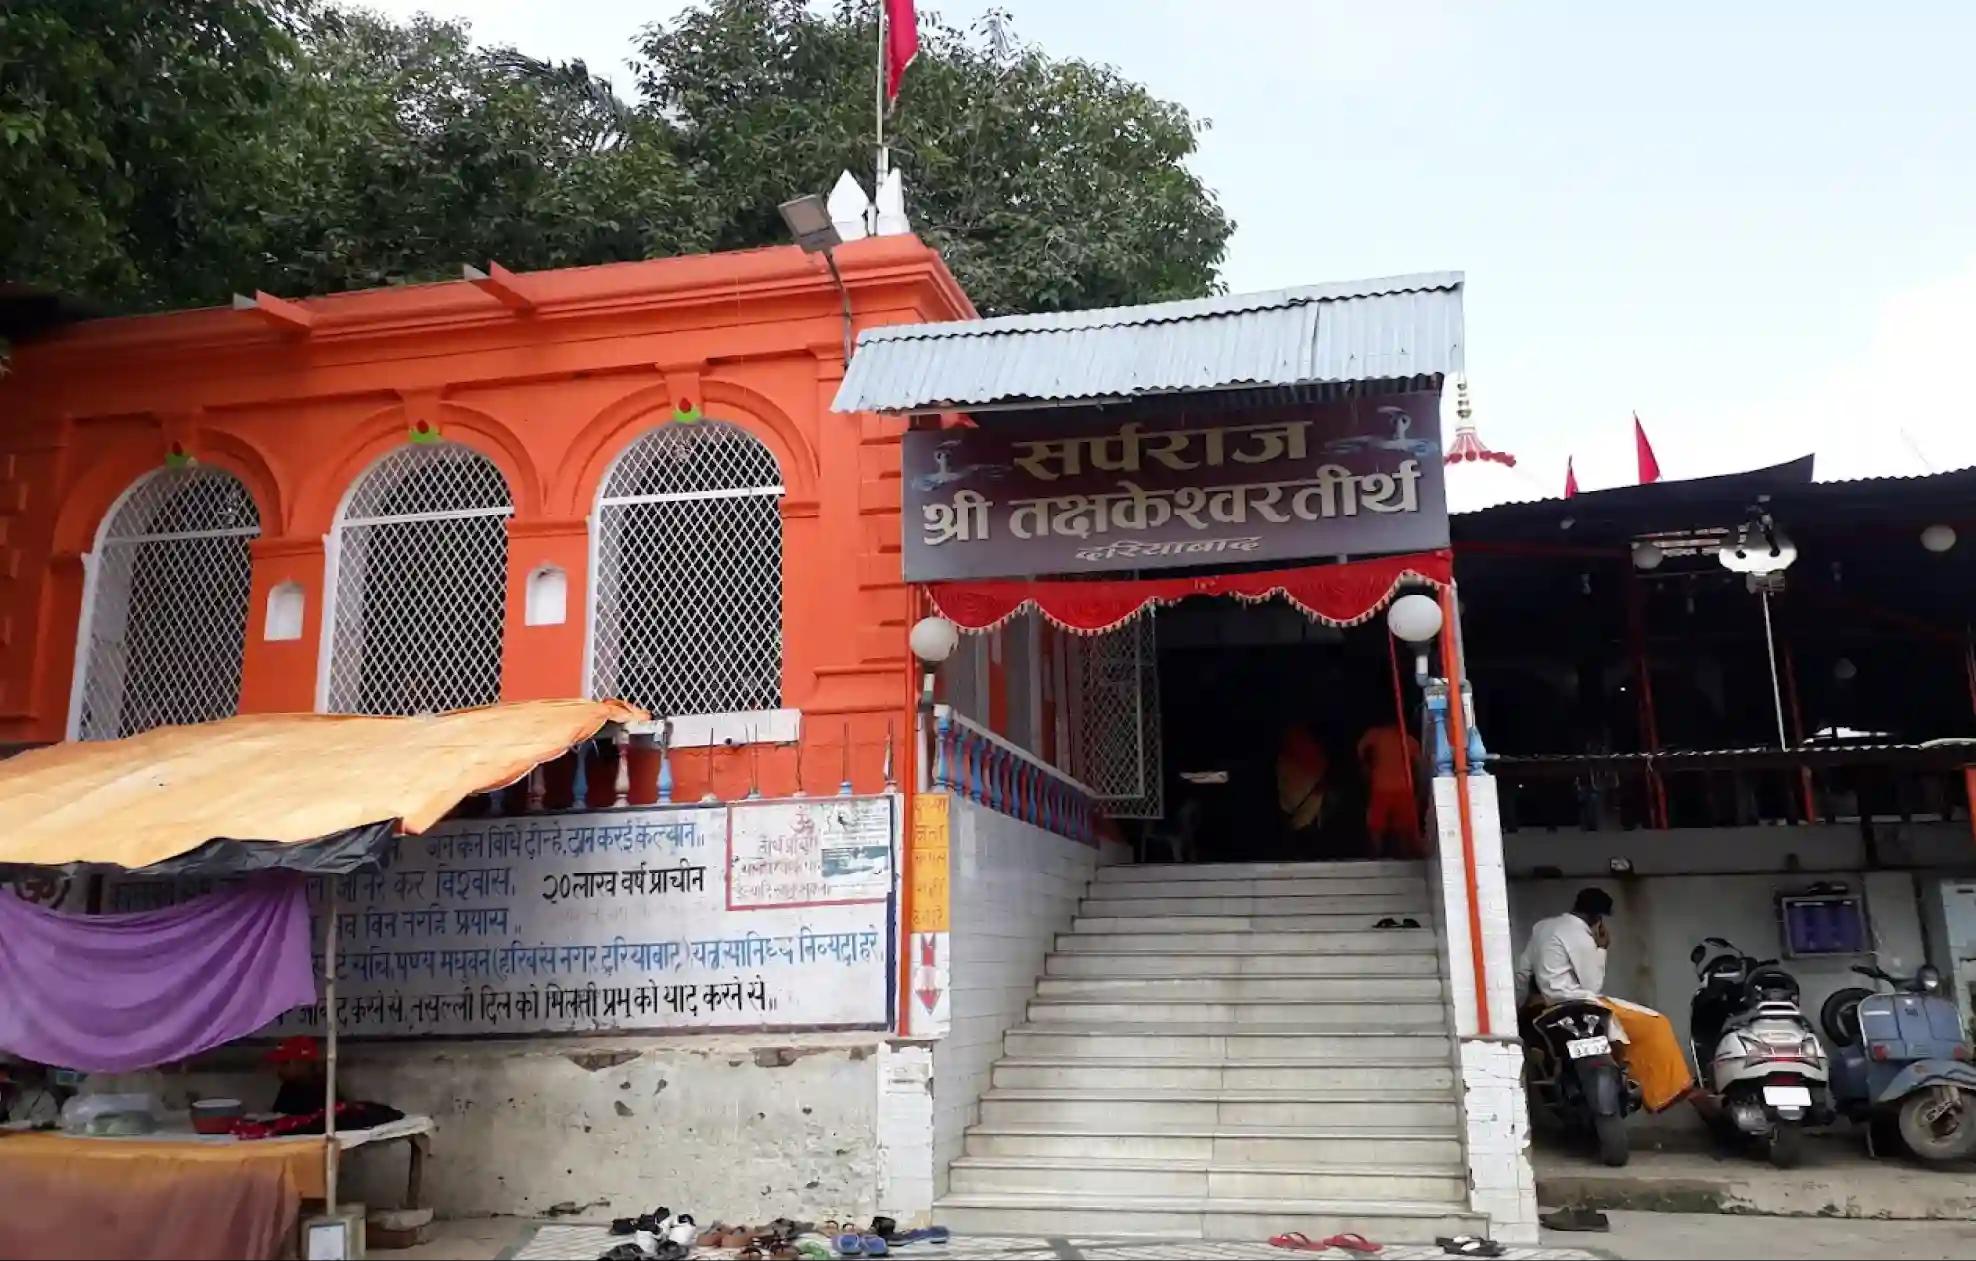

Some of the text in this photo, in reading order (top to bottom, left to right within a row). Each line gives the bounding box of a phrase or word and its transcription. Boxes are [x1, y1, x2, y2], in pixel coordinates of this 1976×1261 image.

[1012, 421, 1313, 481] सर्पराज
[922, 489, 994, 546] श्री
[395, 870, 425, 901] कर
[621, 861, 647, 895] वर्ष
[649, 858, 707, 895] प्राचीन
[480, 984, 511, 1024] दिल
[515, 983, 539, 1021] को
[633, 978, 659, 1015] को
[663, 984, 698, 1018] याद
[703, 977, 742, 1012] करने
